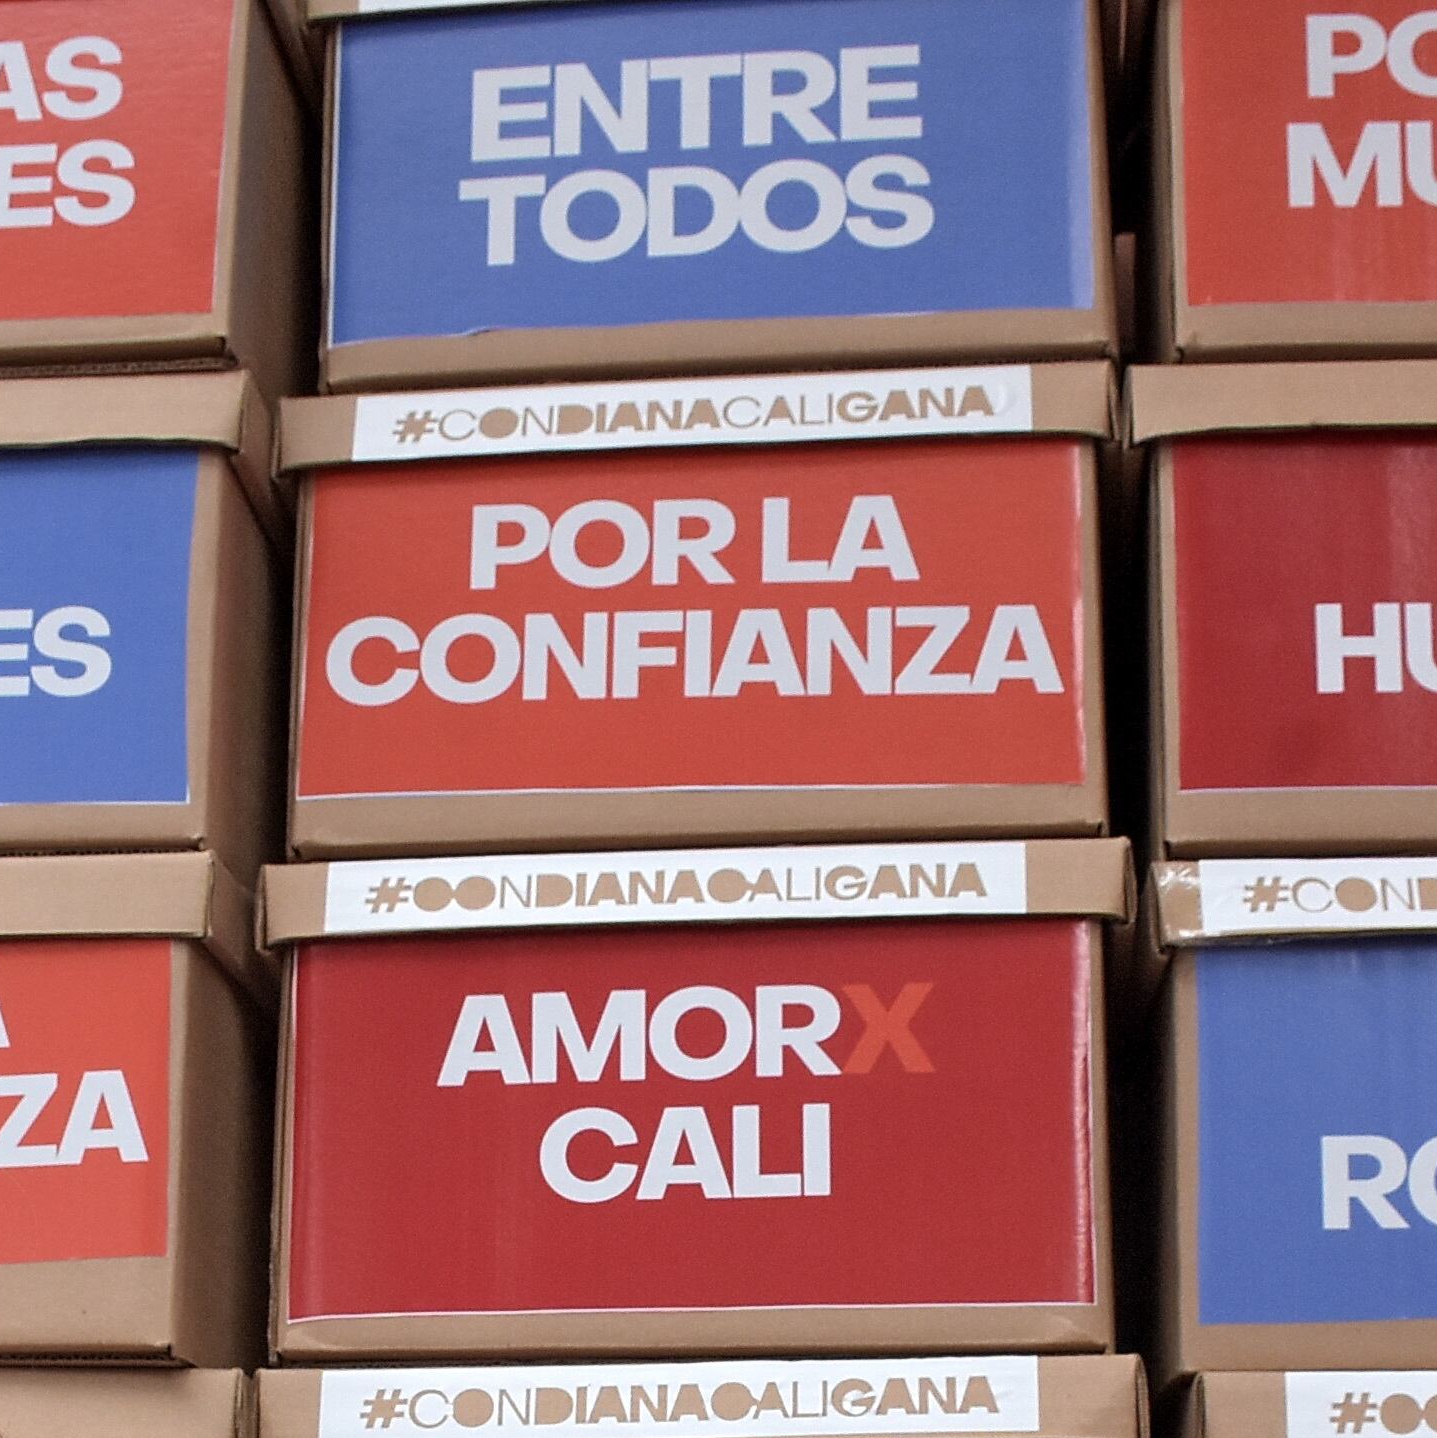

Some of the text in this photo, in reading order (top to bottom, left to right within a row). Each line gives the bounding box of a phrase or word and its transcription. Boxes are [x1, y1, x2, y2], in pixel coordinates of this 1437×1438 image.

[472, 45, 925, 162] ENTRE
[460, 155, 933, 264] TODOS
[471, 496, 919, 589] POR LA
[327, 606, 1063, 705] CONFIANZA
[540, 1104, 830, 1202] CALI
